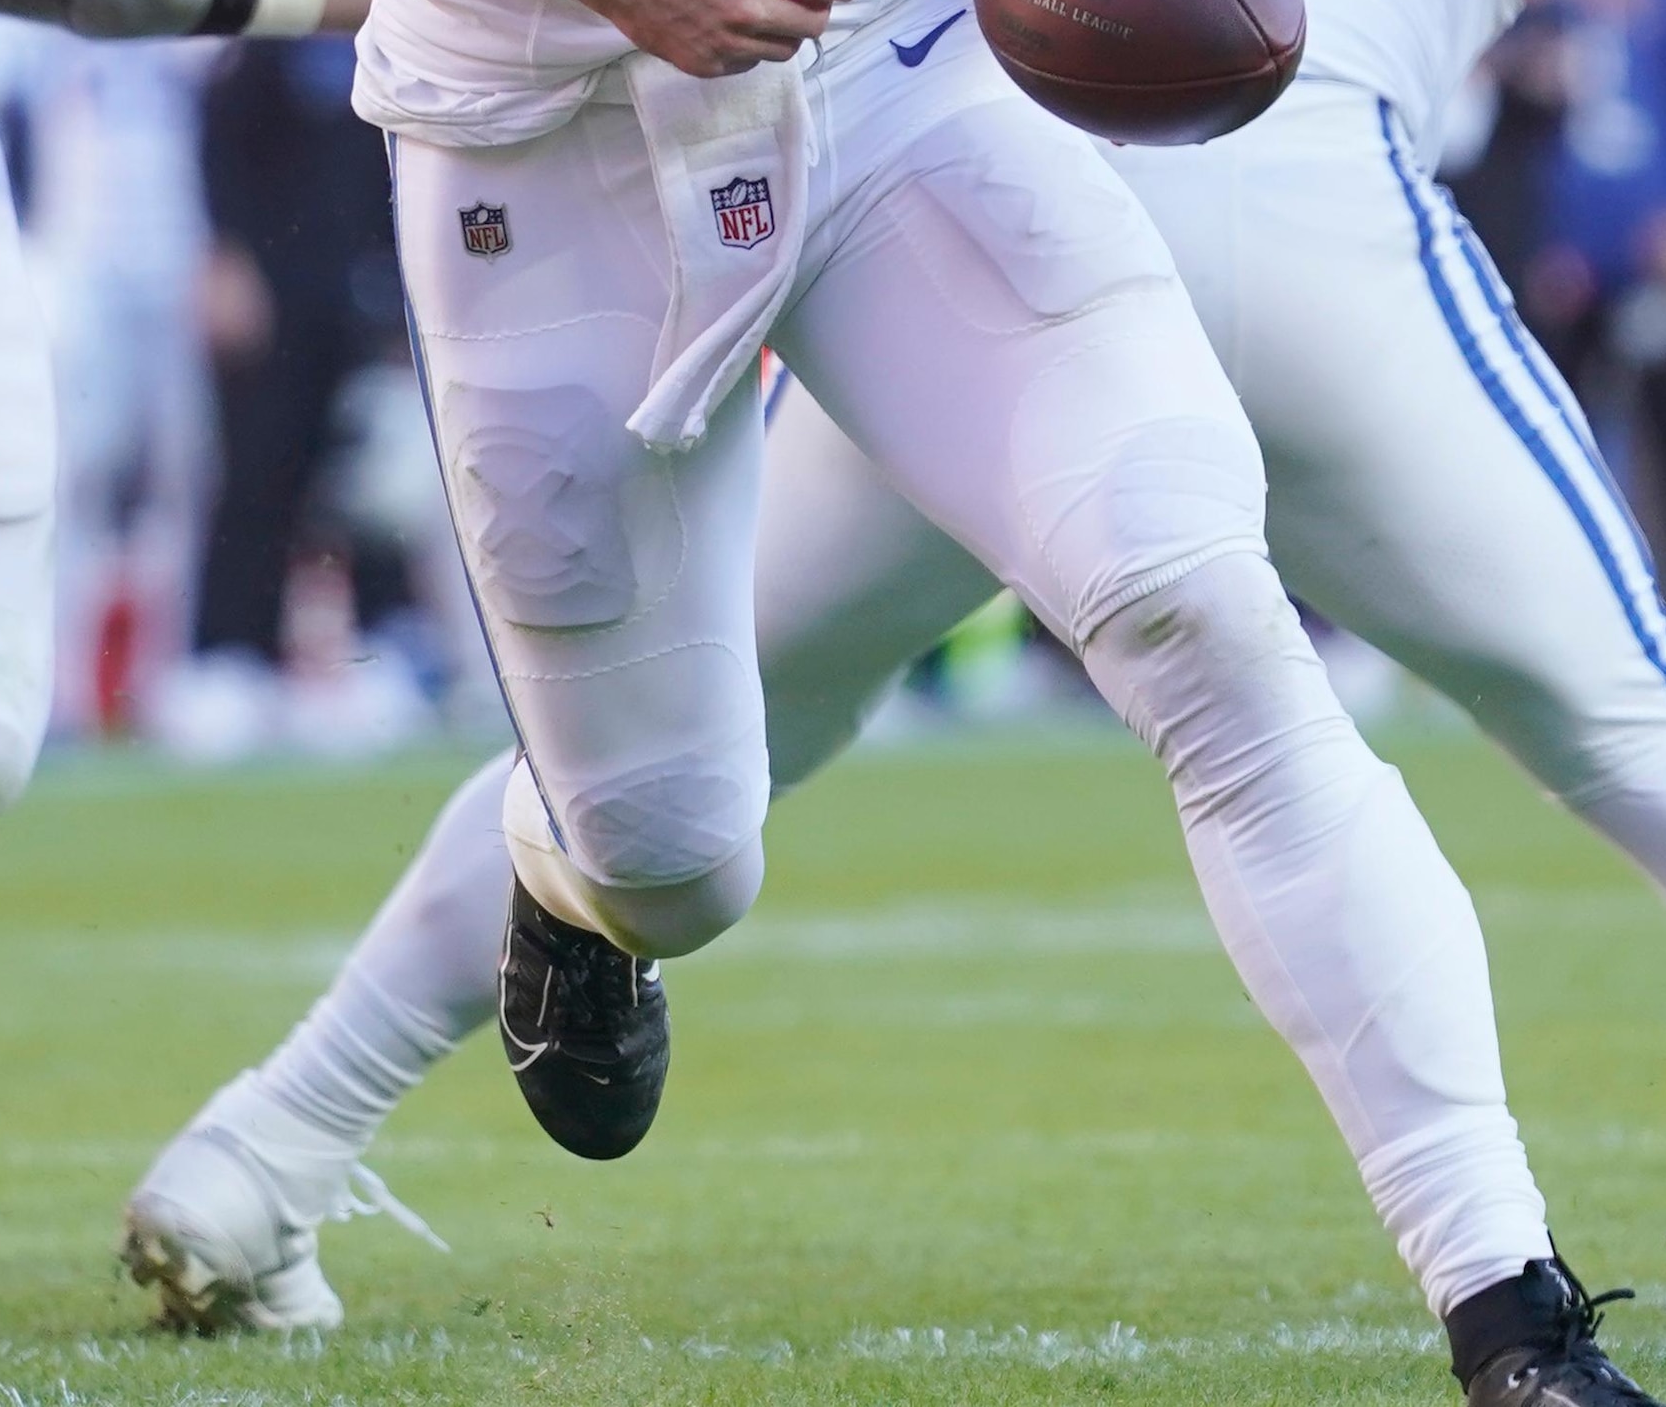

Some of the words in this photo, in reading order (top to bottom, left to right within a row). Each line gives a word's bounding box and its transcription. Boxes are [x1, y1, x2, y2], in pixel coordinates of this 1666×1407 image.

[1072, 7, 1134, 40] LEAGUE
[467, 225, 505, 250] NFL
[719, 204, 769, 242] NFL
